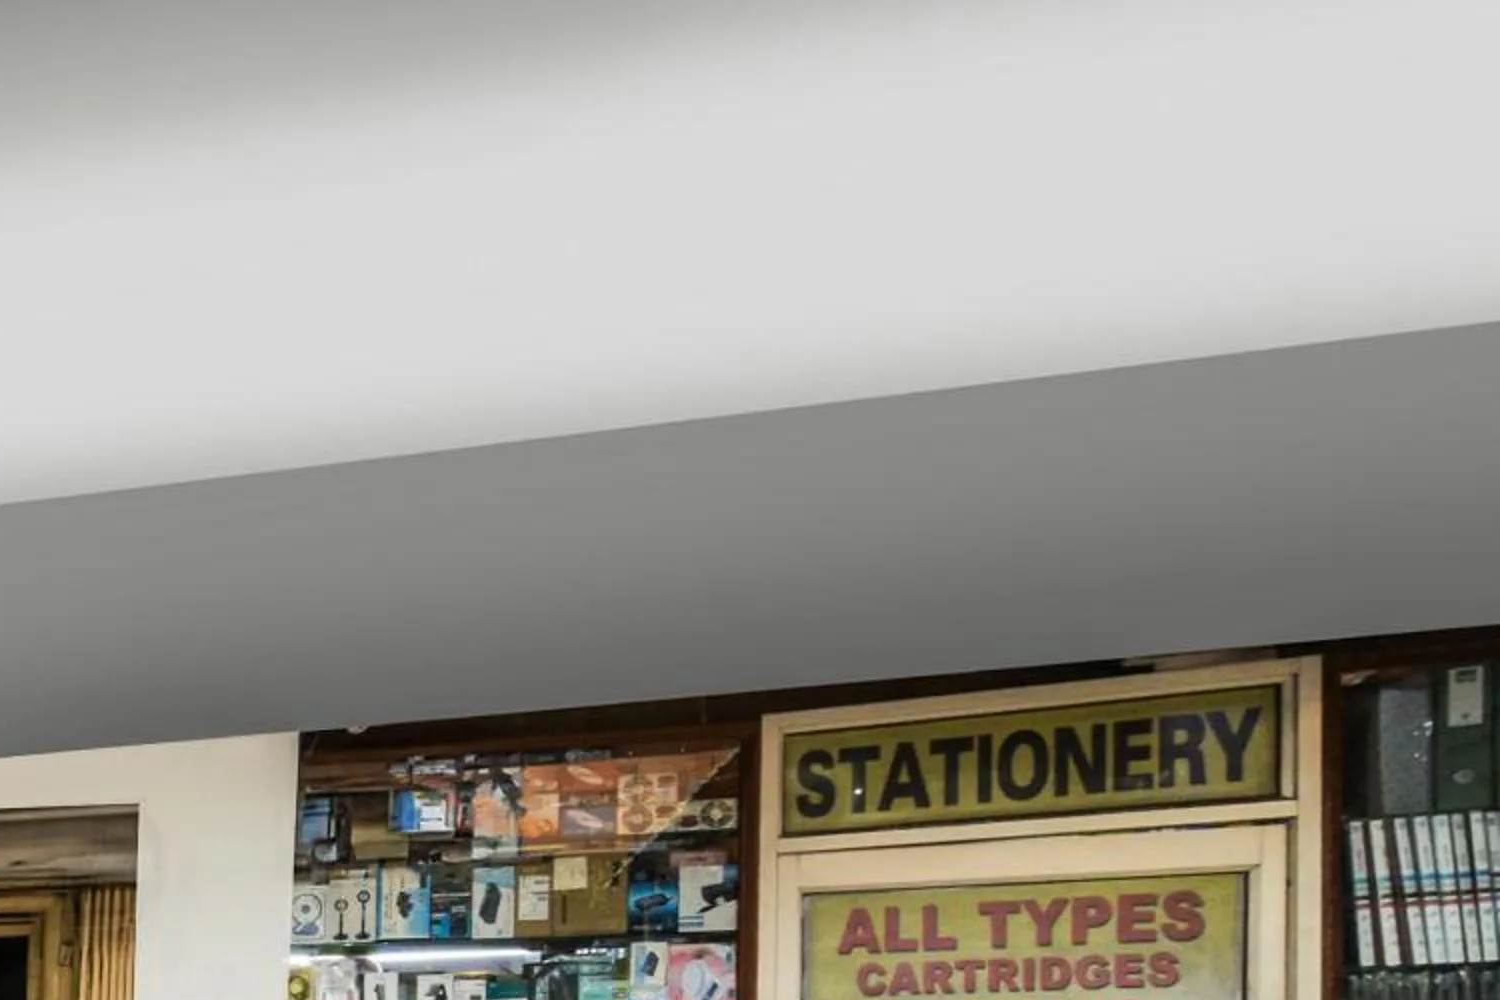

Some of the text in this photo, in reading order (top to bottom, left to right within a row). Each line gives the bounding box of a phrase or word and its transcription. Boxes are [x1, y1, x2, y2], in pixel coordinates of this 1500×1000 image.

[794, 706, 1262, 818] STATIONERY
[838, 889, 1206, 955] ALL TYPES
[856, 951, 1181, 997] CARTRIDGES
